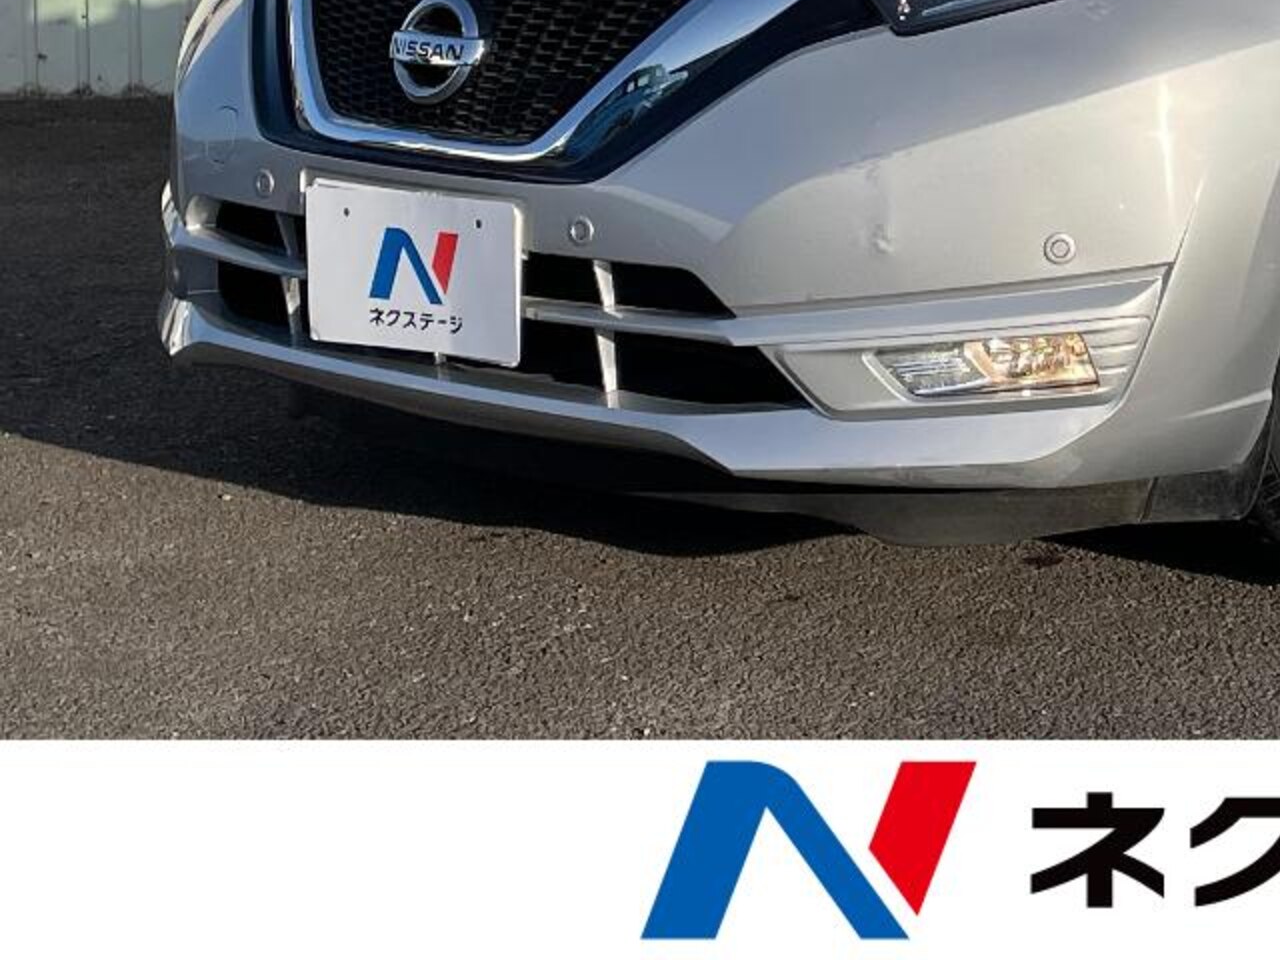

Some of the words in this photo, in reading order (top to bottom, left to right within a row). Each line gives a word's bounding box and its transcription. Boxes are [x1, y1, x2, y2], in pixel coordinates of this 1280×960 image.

[394, 37, 465, 60] NISSAN
[369, 307, 463, 334] ネクステージ
